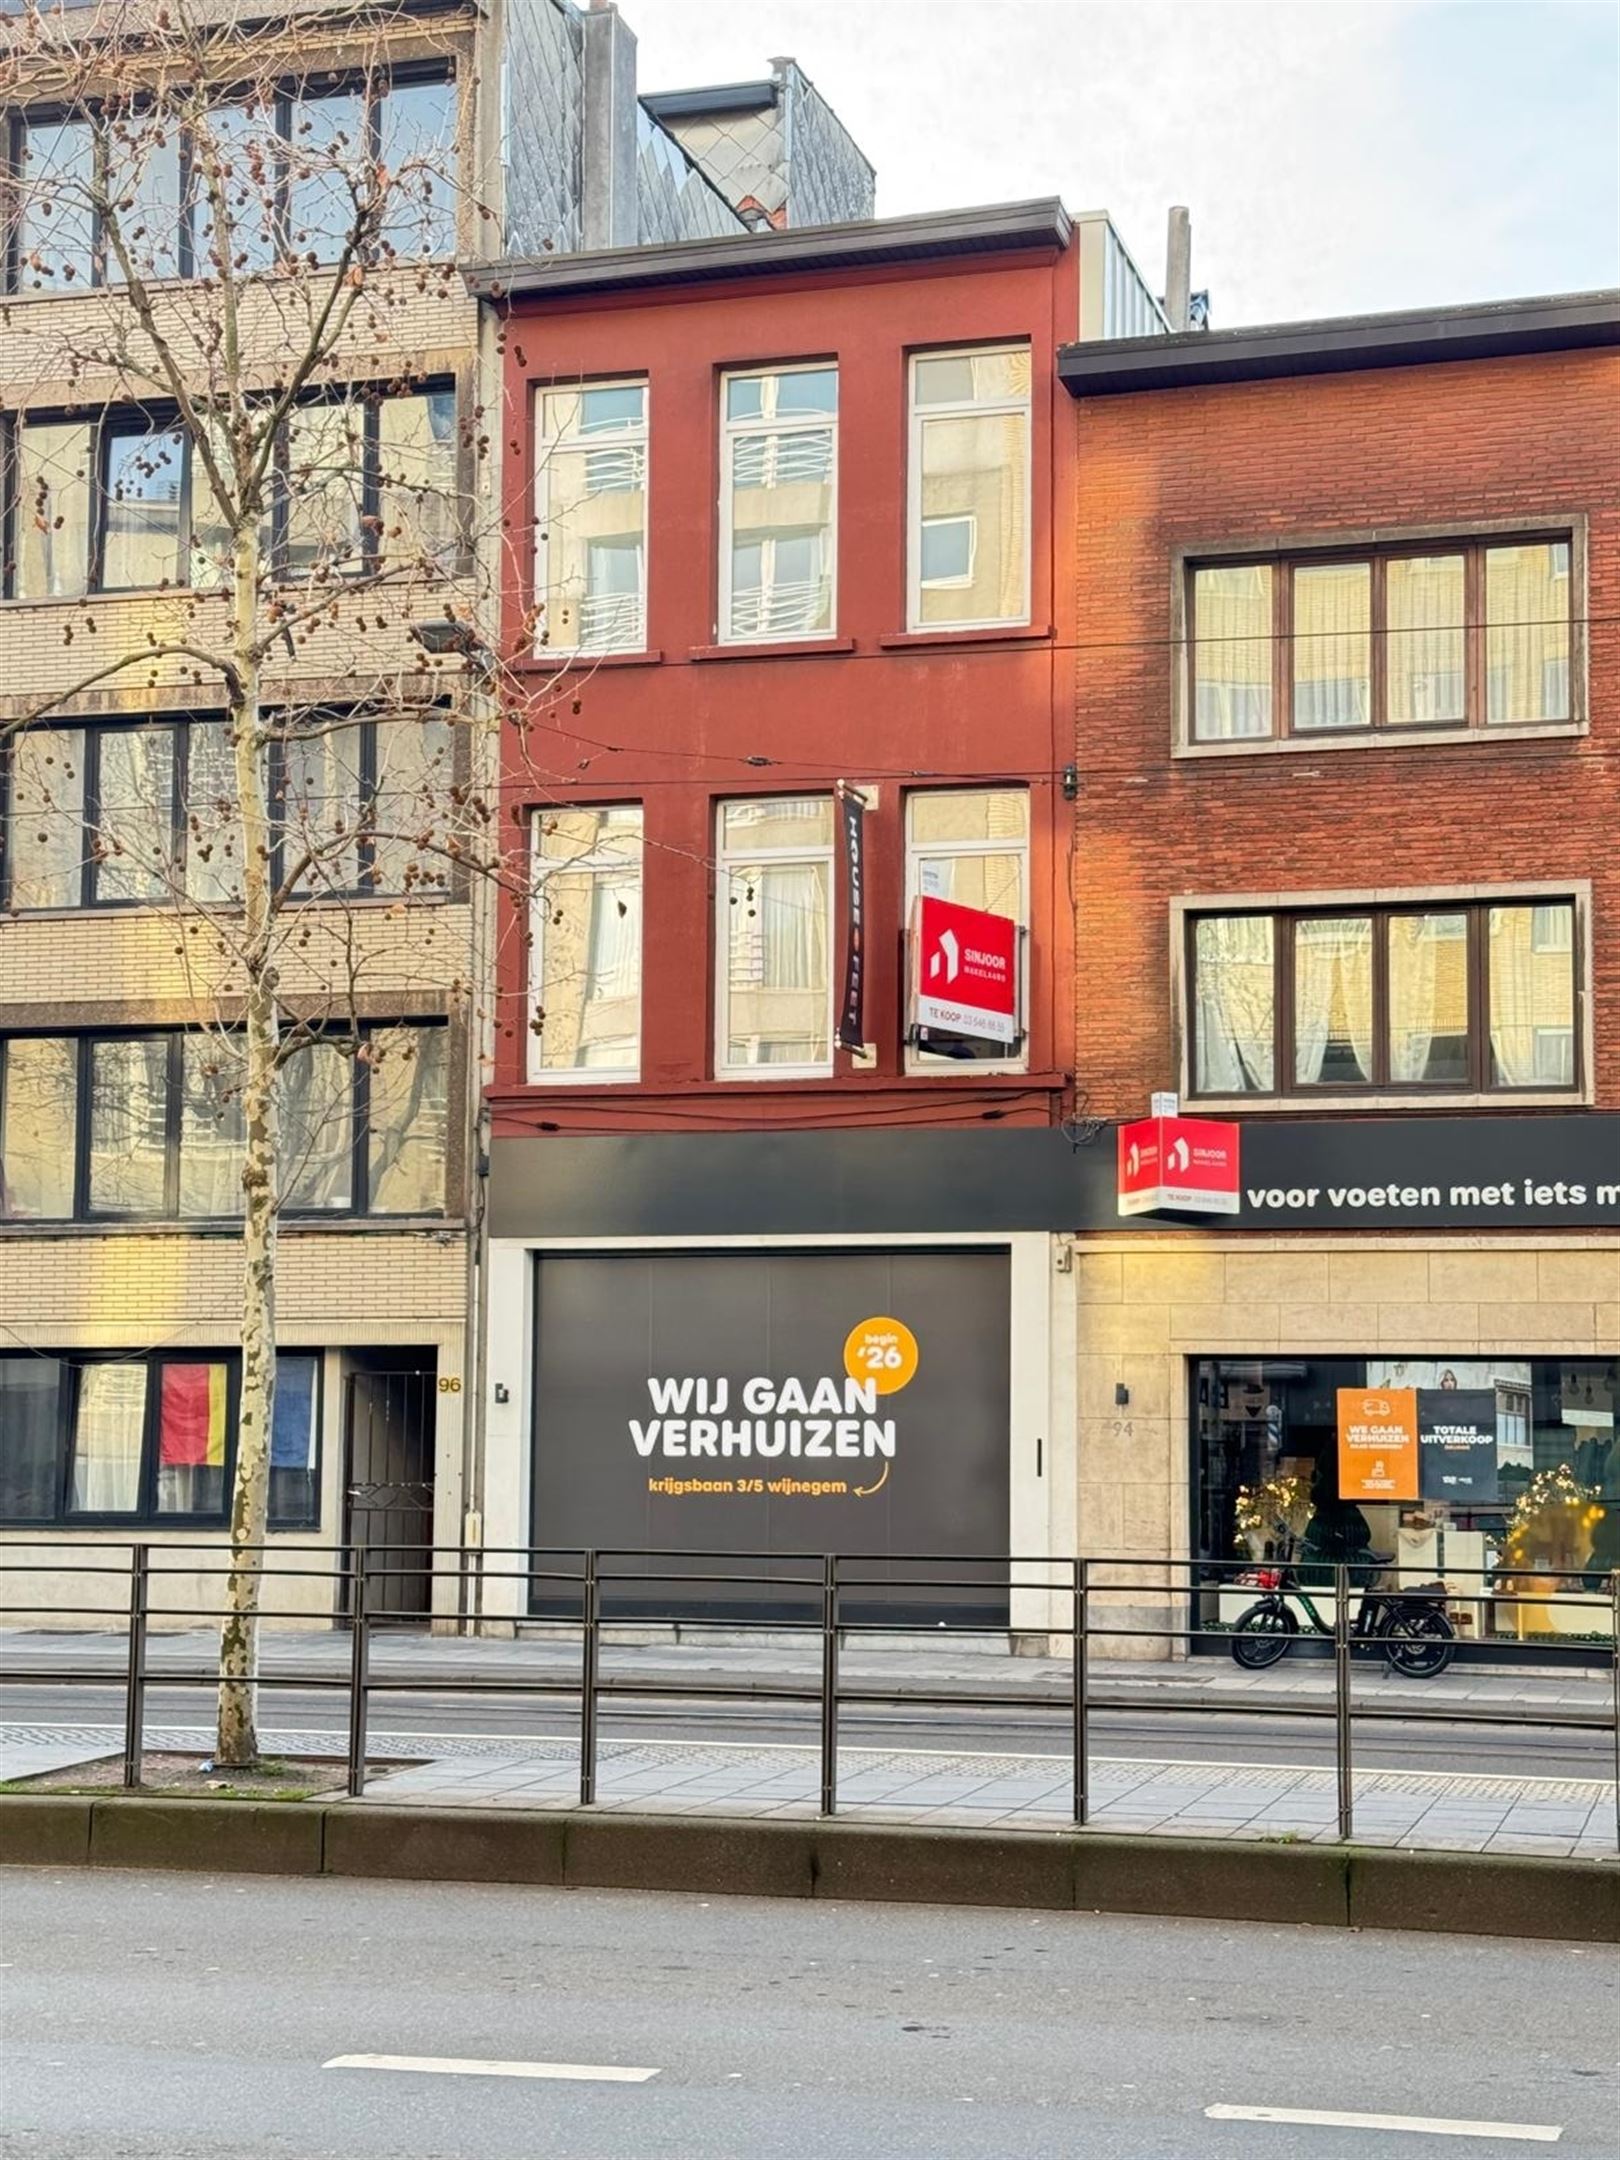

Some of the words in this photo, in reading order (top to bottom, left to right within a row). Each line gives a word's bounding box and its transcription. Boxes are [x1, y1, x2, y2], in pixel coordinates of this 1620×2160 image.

[963, 948, 1006, 969] SINJOOR
[928, 1006, 939, 1018] TE
[940, 1010, 961, 1023] KOOP
[1247, 1188, 1320, 1208] voor
[1327, 1184, 1440, 1207] voeten
[1450, 1183, 1514, 1206] met
[1524, 1178, 1587, 1205] iets
[864, 1333, 898, 1346] begin
[439, 1377, 462, 1393] 96
[647, 1377, 729, 1415] WIJ
[742, 1377, 878, 1415] GAAN
[1112, 1421, 1134, 1438] 94
[1348, 1425, 1368, 1435] WE
[1370, 1425, 1403, 1435] GAAN
[1433, 1425, 1477, 1435] TOTALE
[628, 1420, 896, 1457] VERHUIZEN
[1345, 1434, 1410, 1444] VERHUIZEN
[1420, 1434, 1494, 1444] UITVERKOOP
[648, 1477, 733, 1496] krijgsbaan
[737, 1478, 764, 1493] 3/5
[767, 1478, 847, 1496] wijnegem
